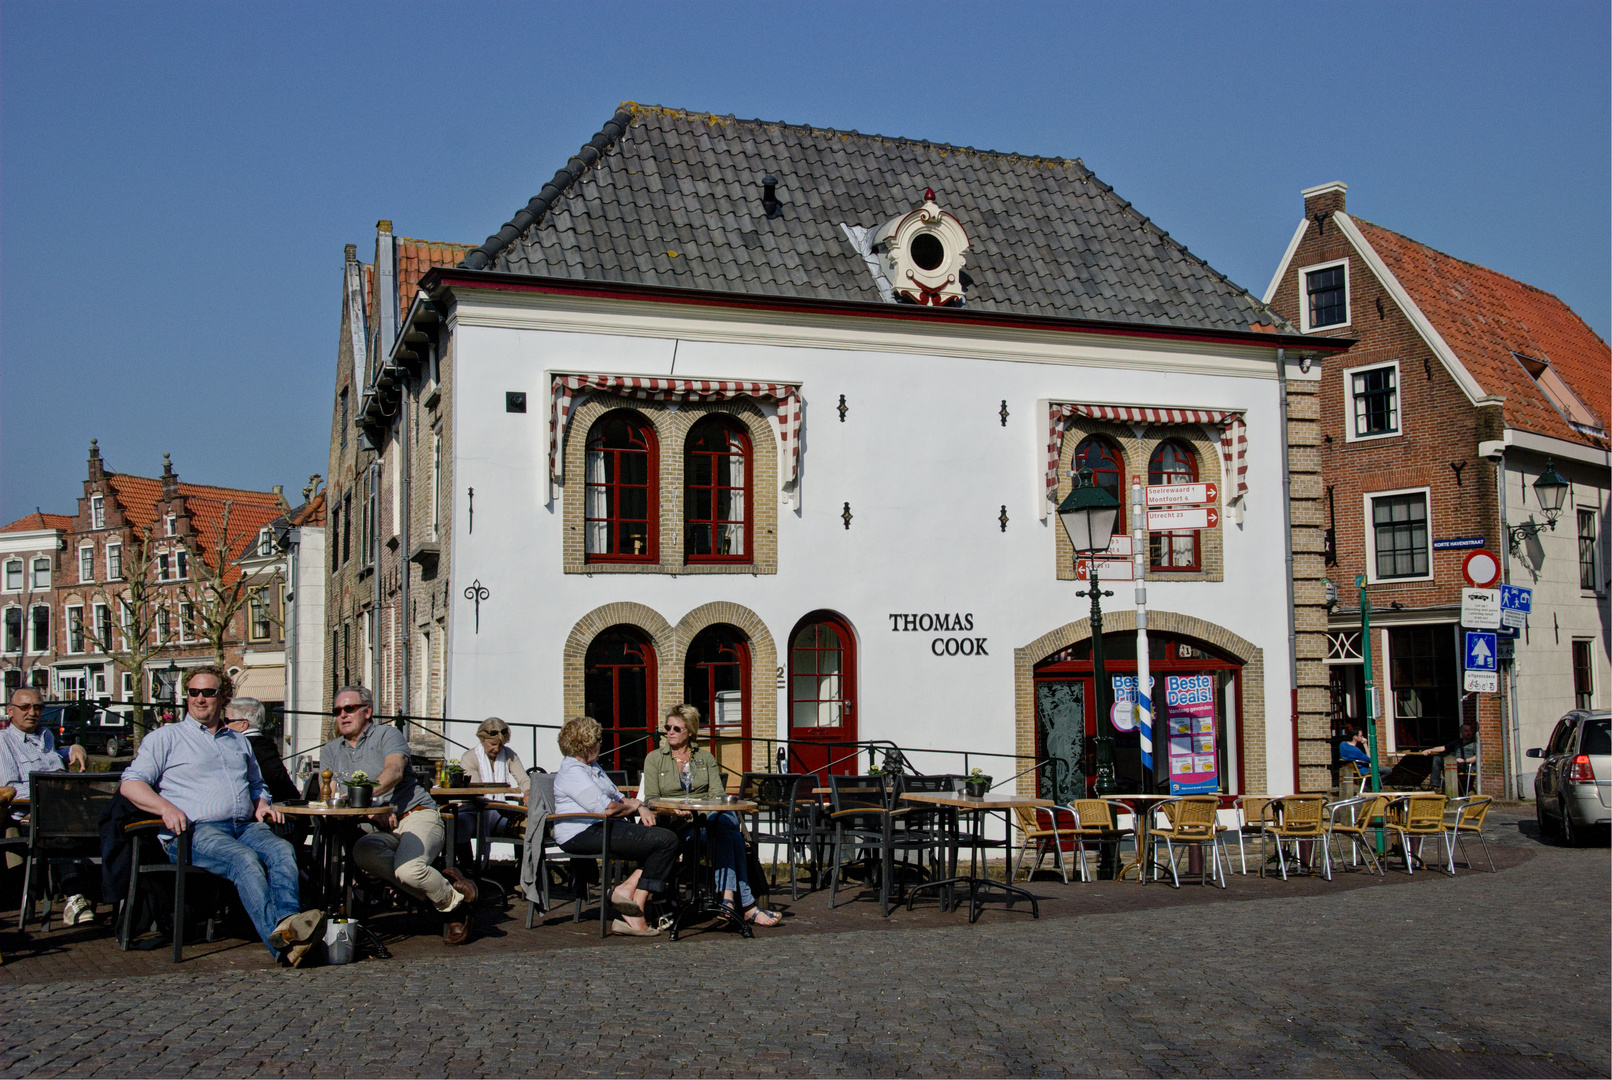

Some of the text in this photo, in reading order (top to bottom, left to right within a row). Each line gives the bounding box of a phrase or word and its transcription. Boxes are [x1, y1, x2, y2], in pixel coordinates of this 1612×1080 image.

[1148, 486, 1190, 494] Snelrewaard
[889, 613, 974, 632] THOMAS
[931, 637, 989, 656] COOK
[1168, 674, 1210, 691] Beste
[1115, 687, 1140, 704] Prij
[1167, 687, 1212, 706] Deals!
